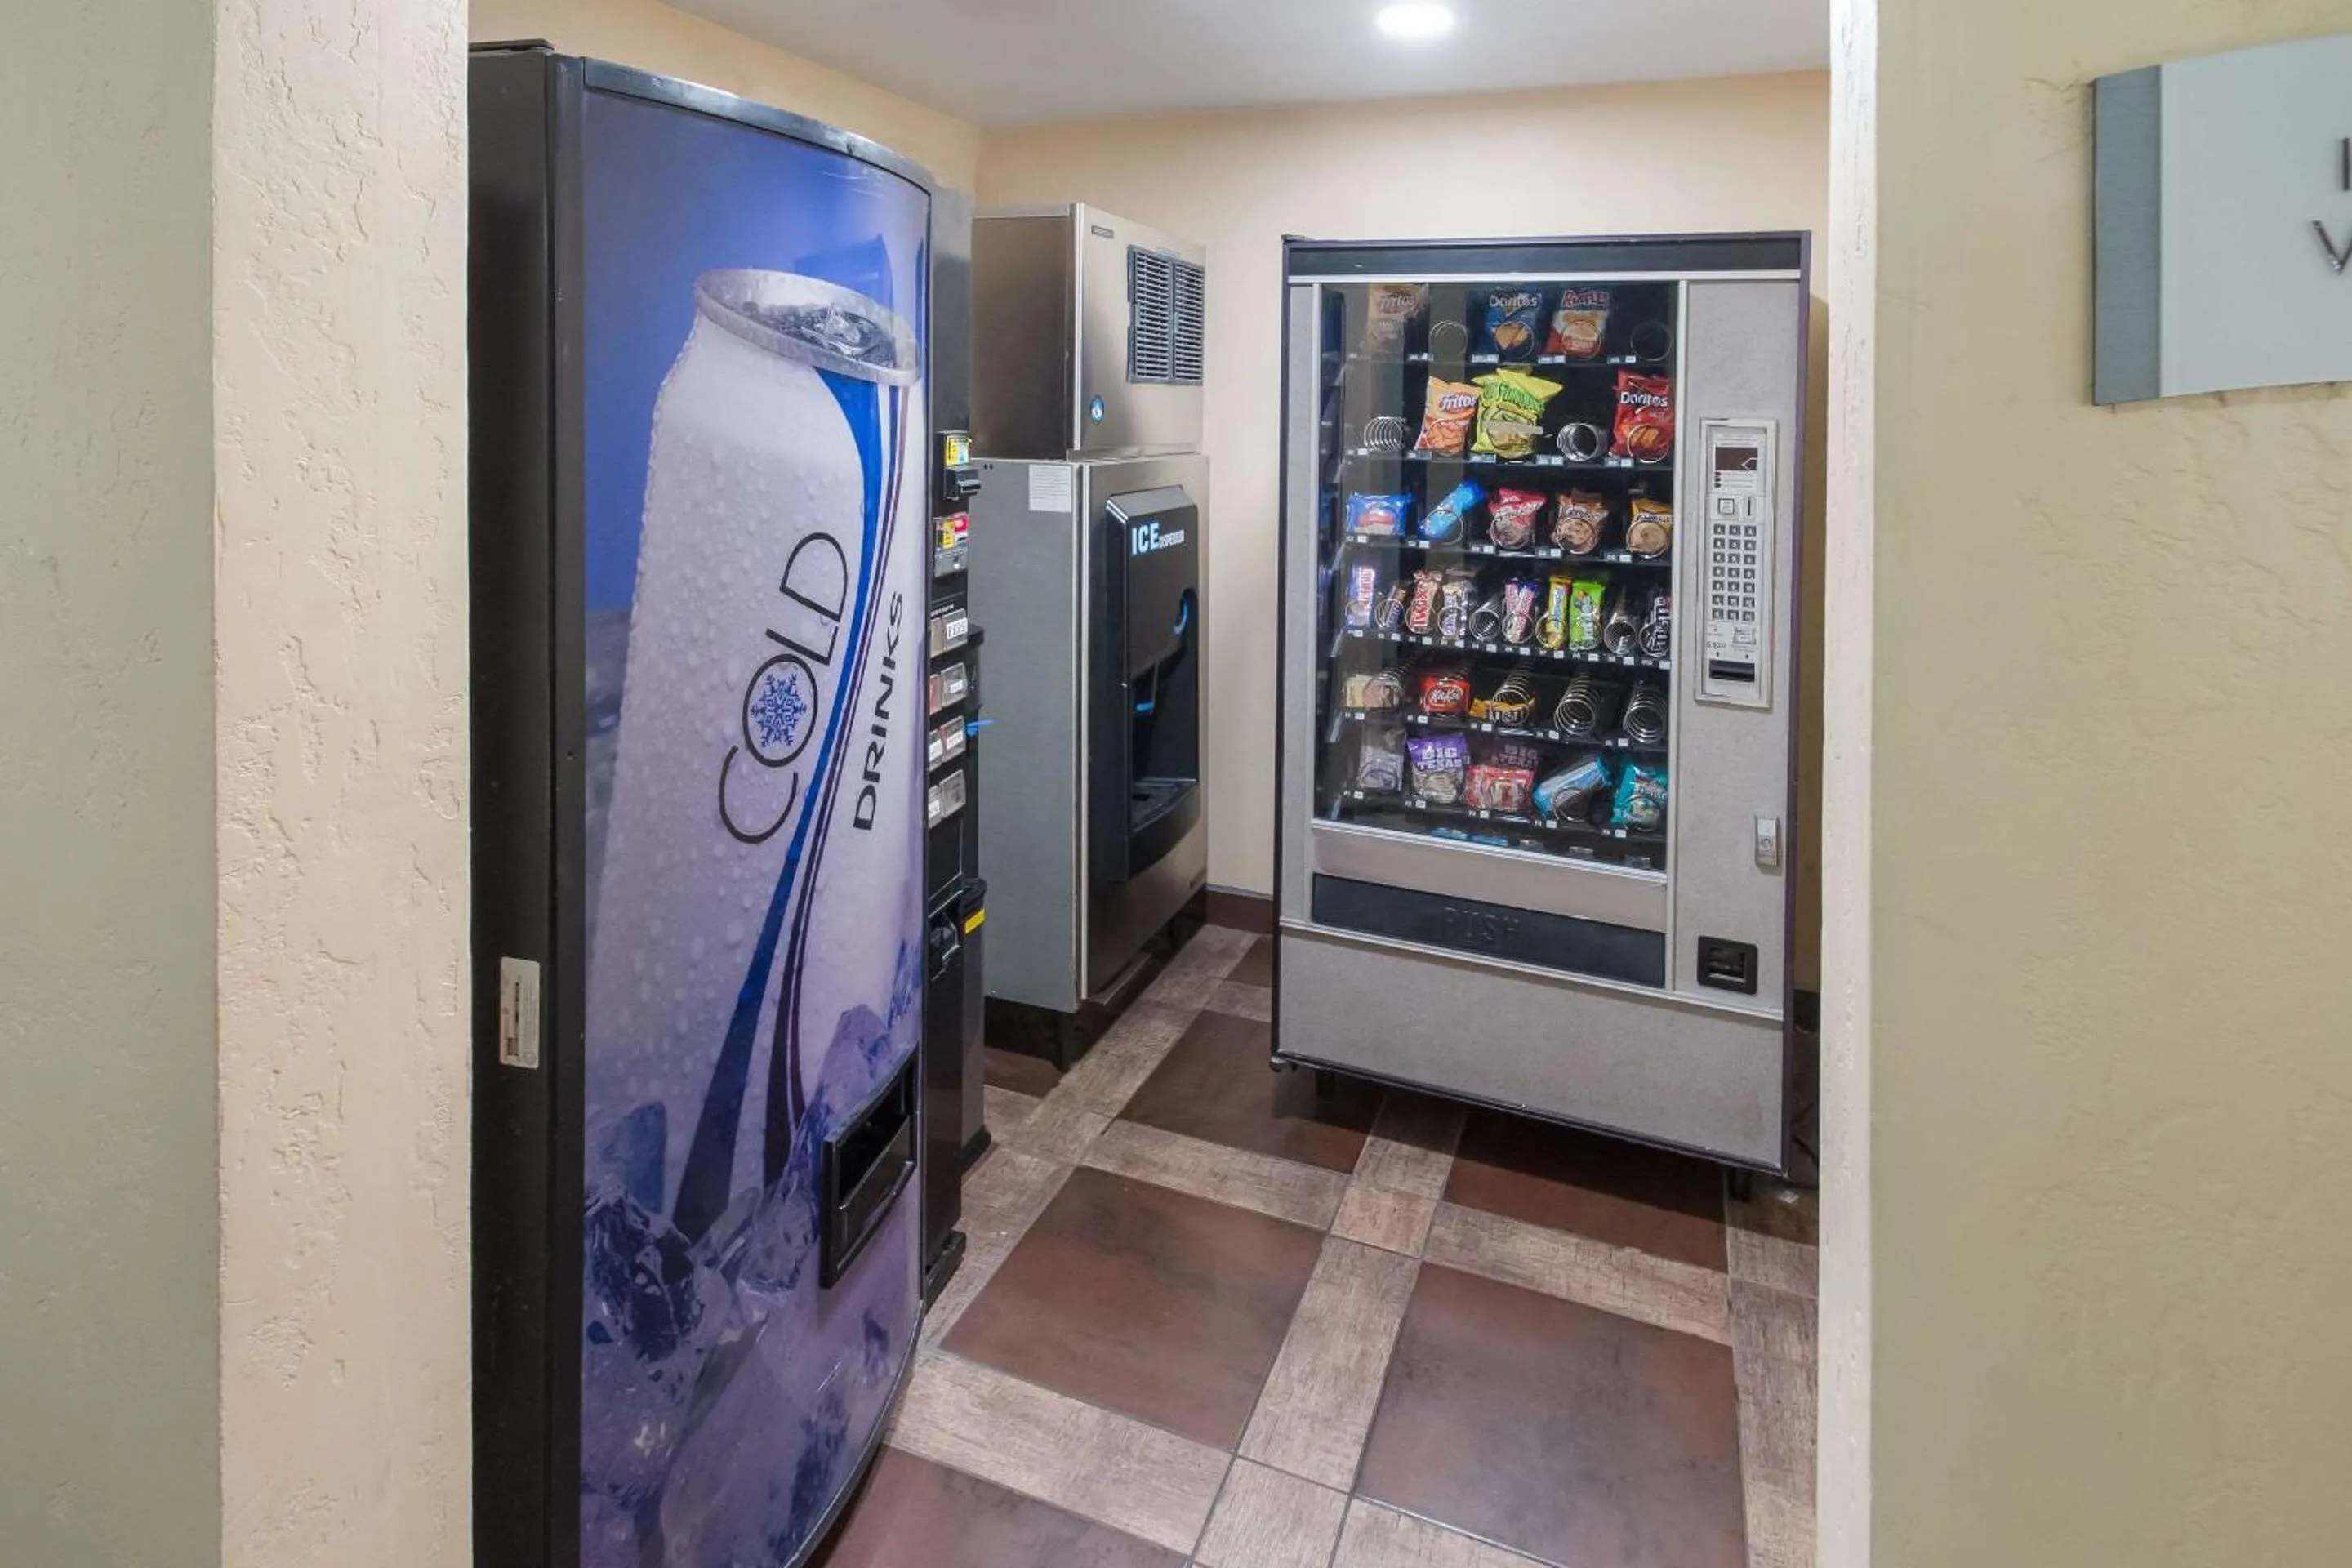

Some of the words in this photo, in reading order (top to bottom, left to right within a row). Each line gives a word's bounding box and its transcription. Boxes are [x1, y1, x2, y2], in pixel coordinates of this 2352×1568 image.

[1620, 391, 1668, 407] Doritos
[1132, 523, 1160, 555] ICE
[719, 532, 849, 844] COLD
[853, 591, 903, 830] DRINKS
[1417, 758, 1463, 769] TEXAS
[1421, 746, 1459, 759] BIG
